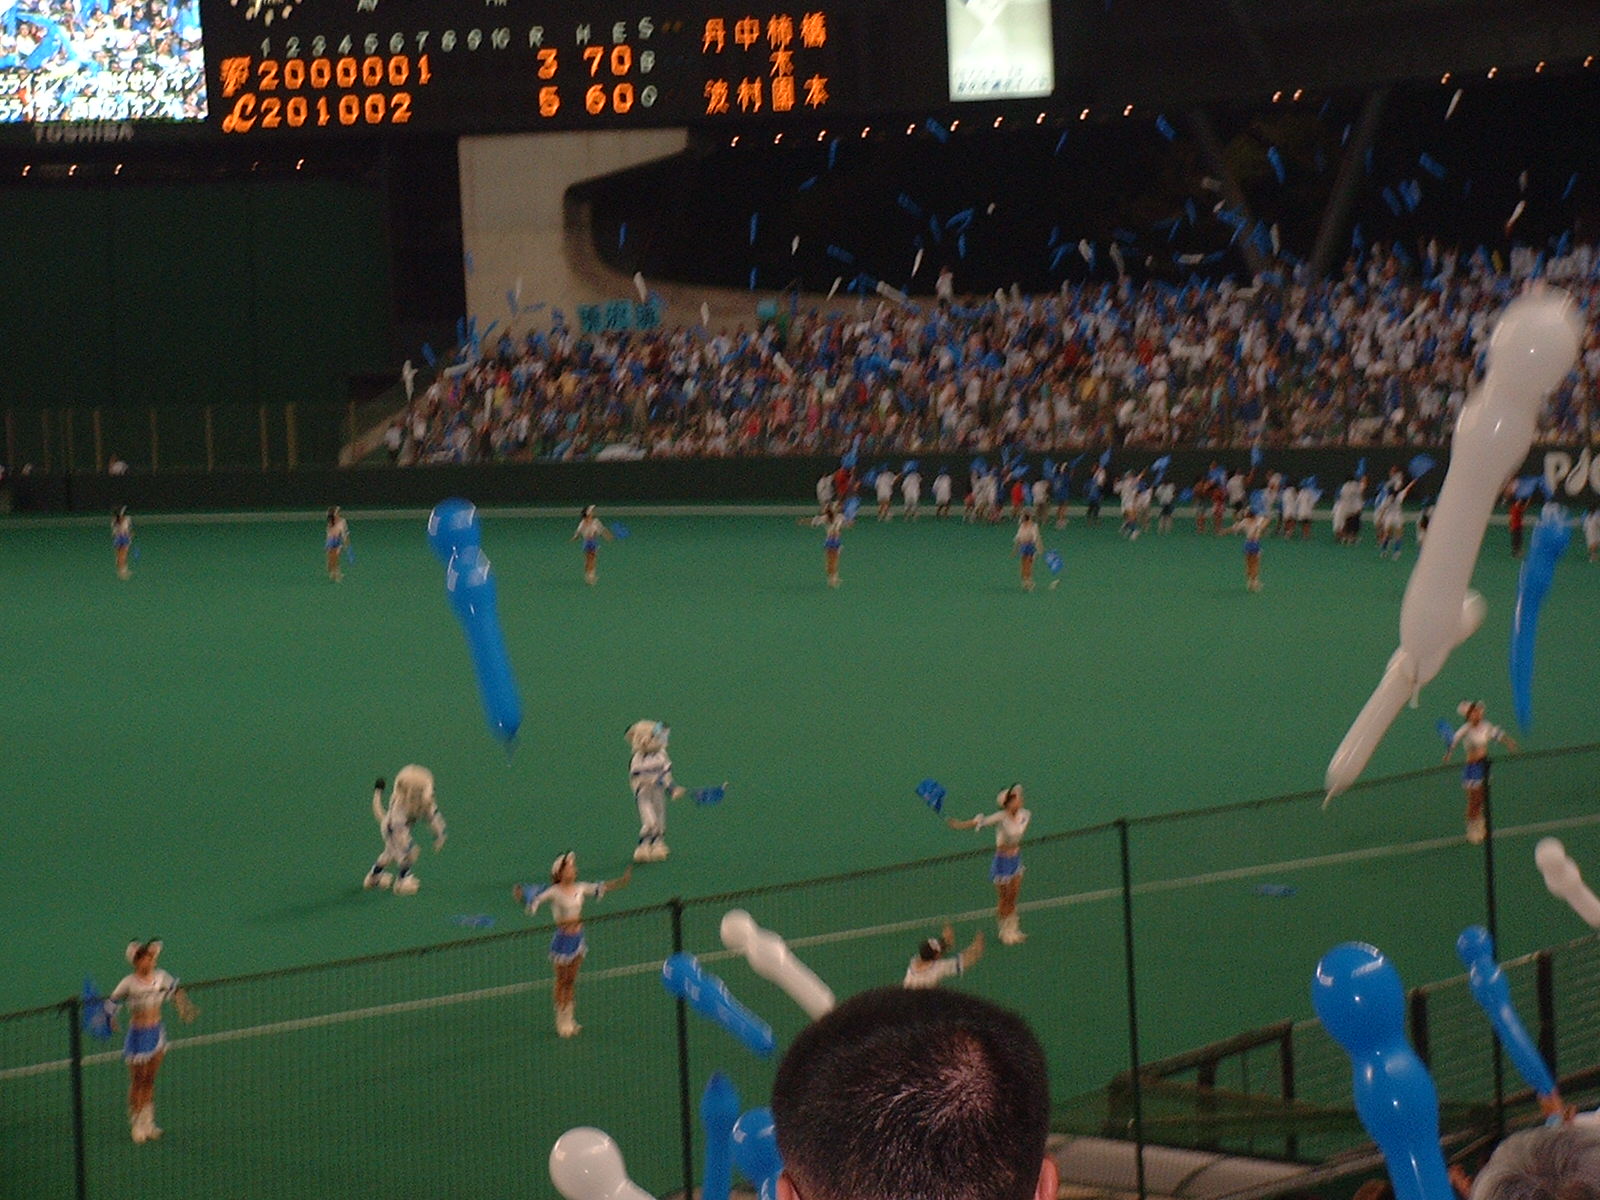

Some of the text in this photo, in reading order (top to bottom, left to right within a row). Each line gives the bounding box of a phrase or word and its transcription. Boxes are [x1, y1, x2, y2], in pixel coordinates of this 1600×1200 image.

[529, 26, 545, 48] R
[612, 22, 628, 44] E
[638, 16, 654, 39] S
[260, 37, 271, 57] 1
[286, 36, 300, 58] 2
[312, 35, 327, 56] 3
[338, 34, 352, 56] 4
[389, 32, 405, 54] 6
[416, 31, 430, 53] 7
[537, 48, 558, 79] 3
